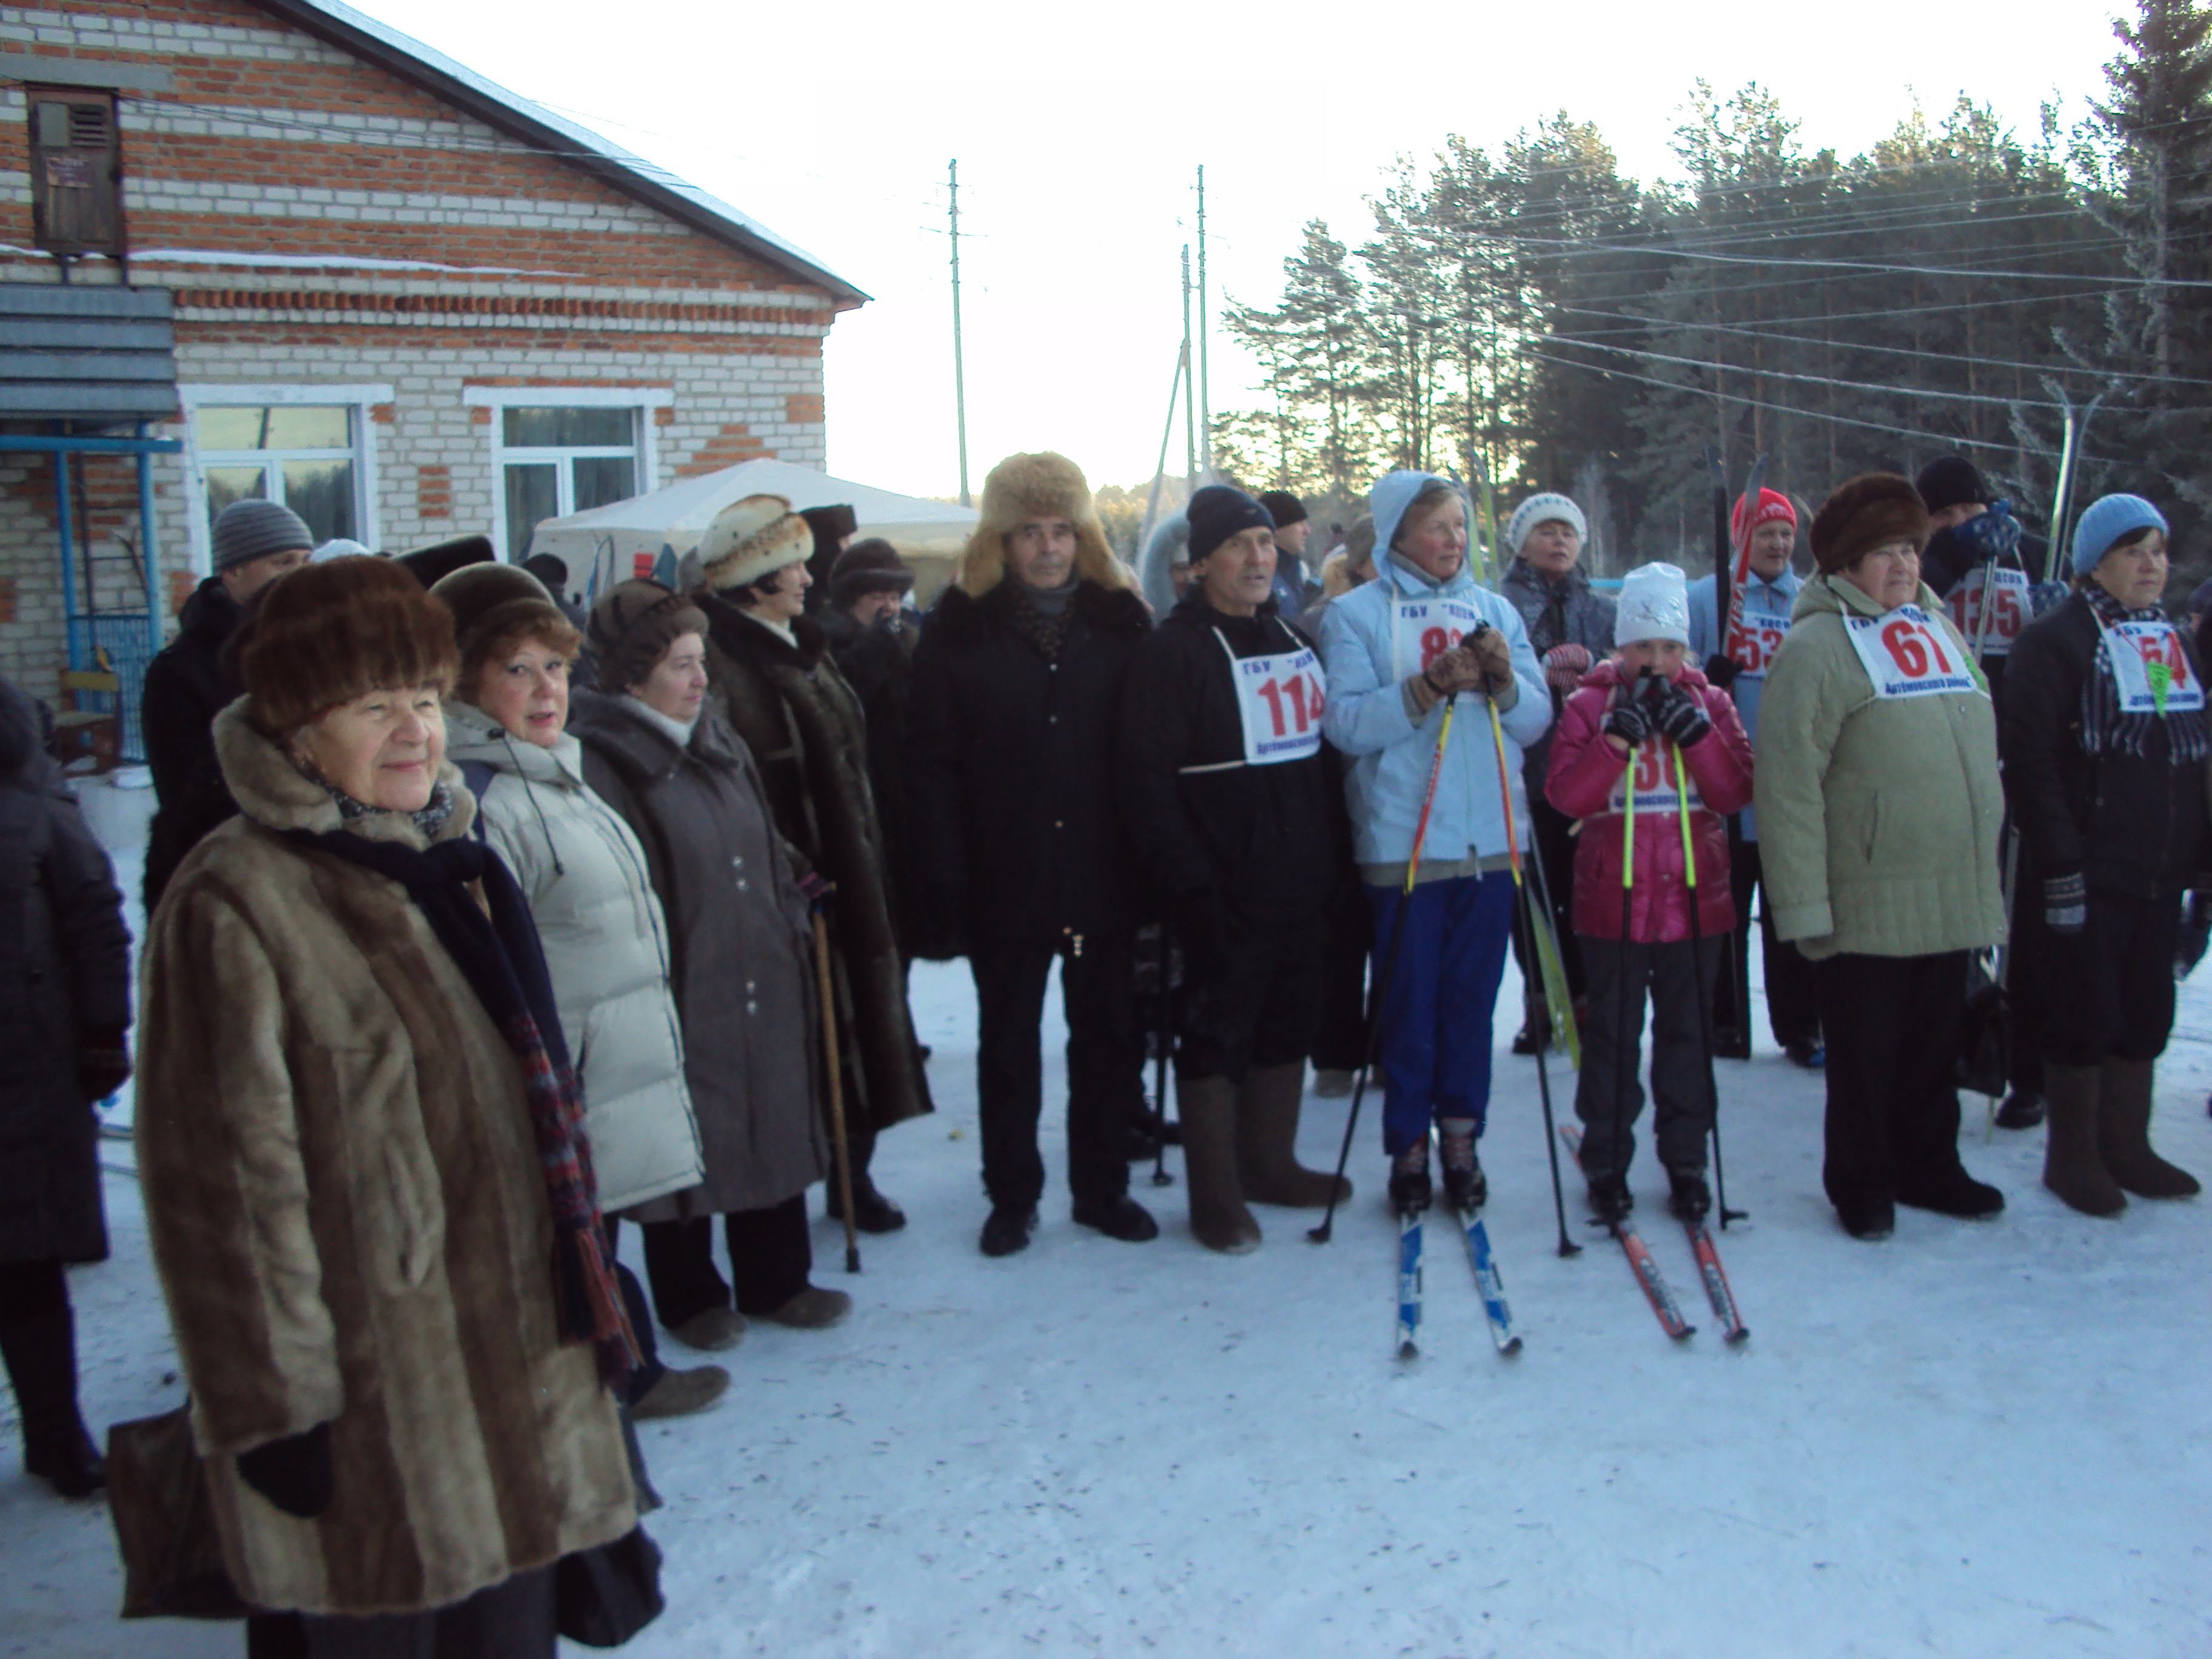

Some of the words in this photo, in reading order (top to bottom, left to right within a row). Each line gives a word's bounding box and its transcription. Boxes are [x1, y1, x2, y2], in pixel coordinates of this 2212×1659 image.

[1401, 605, 1427, 618] ГБУ
[1948, 588, 2021, 637] 135
[1243, 660, 1270, 675] ГБУ
[1882, 620, 1952, 677] 61
[1258, 672, 1326, 736] 114
